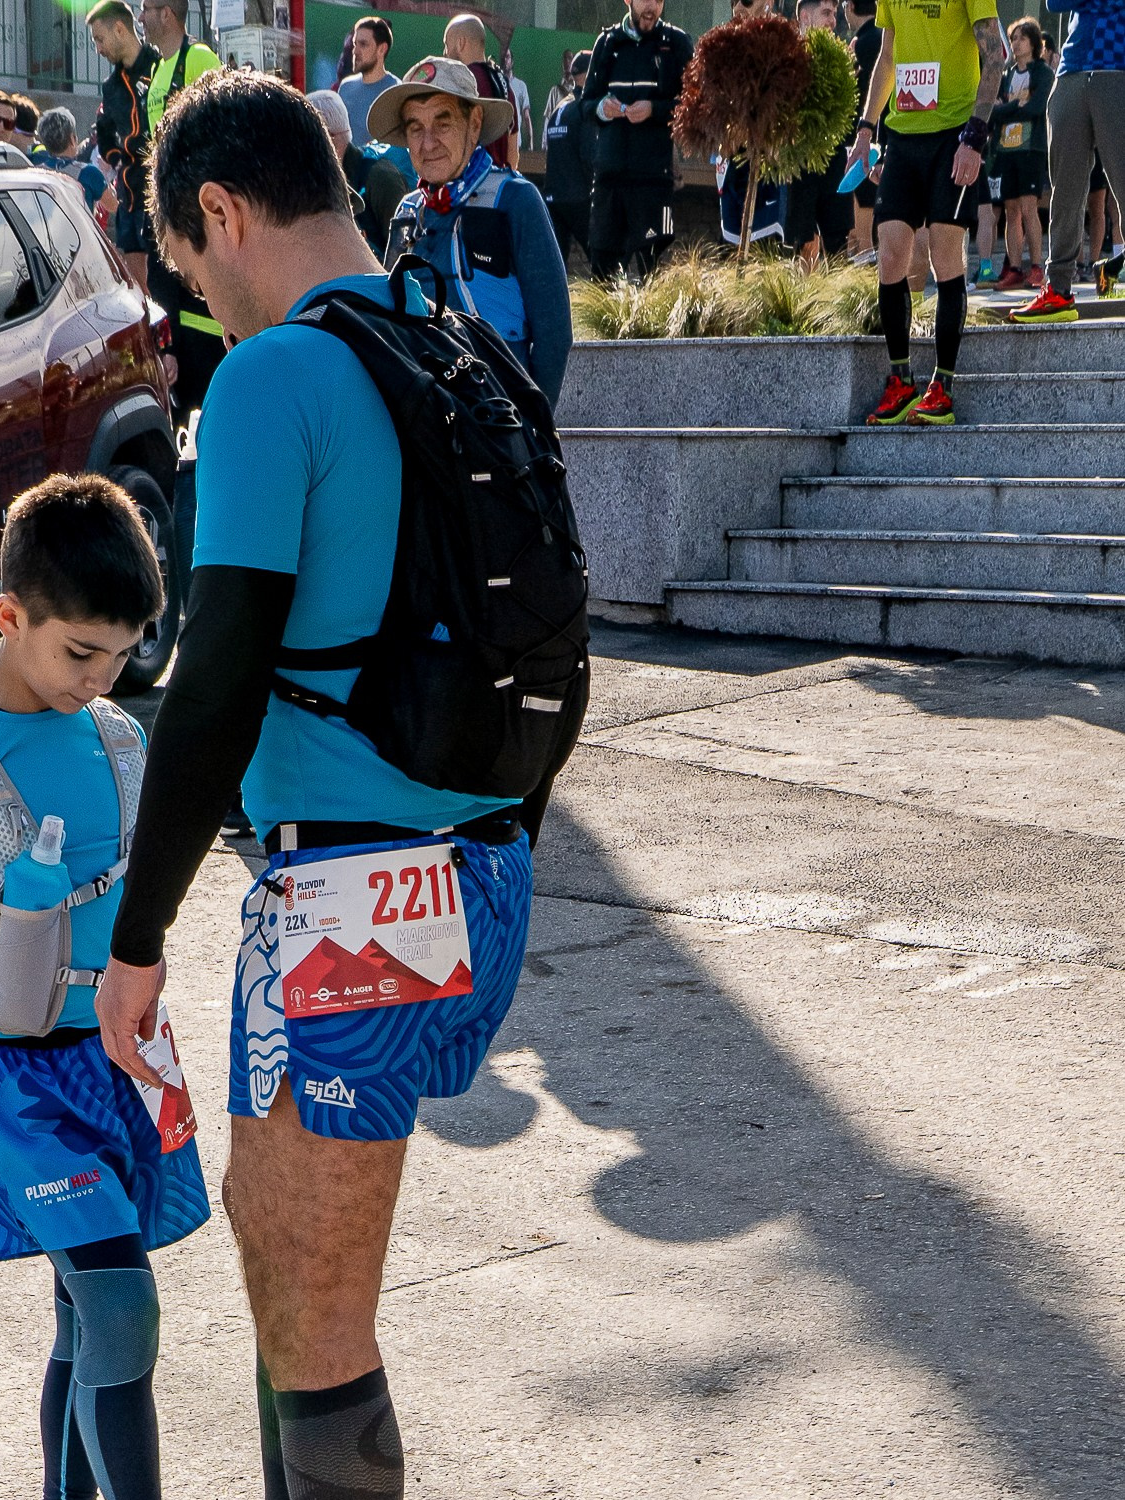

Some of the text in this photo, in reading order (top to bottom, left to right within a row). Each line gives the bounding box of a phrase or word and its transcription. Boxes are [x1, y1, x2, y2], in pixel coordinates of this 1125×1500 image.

[905, 69, 935, 86] 2303
[296, 878, 326, 892] PLOVDIV
[367, 861, 456, 926] 2211
[297, 890, 317, 901] HILLS
[284, 913, 309, 932] 22K
[396, 921, 460, 946] MARKOVO
[396, 943, 434, 962] TRAIL
[25, 1169, 102, 1201] PLOVDIV HILLS
[56, 1188, 94, 1202] MARKOVO
